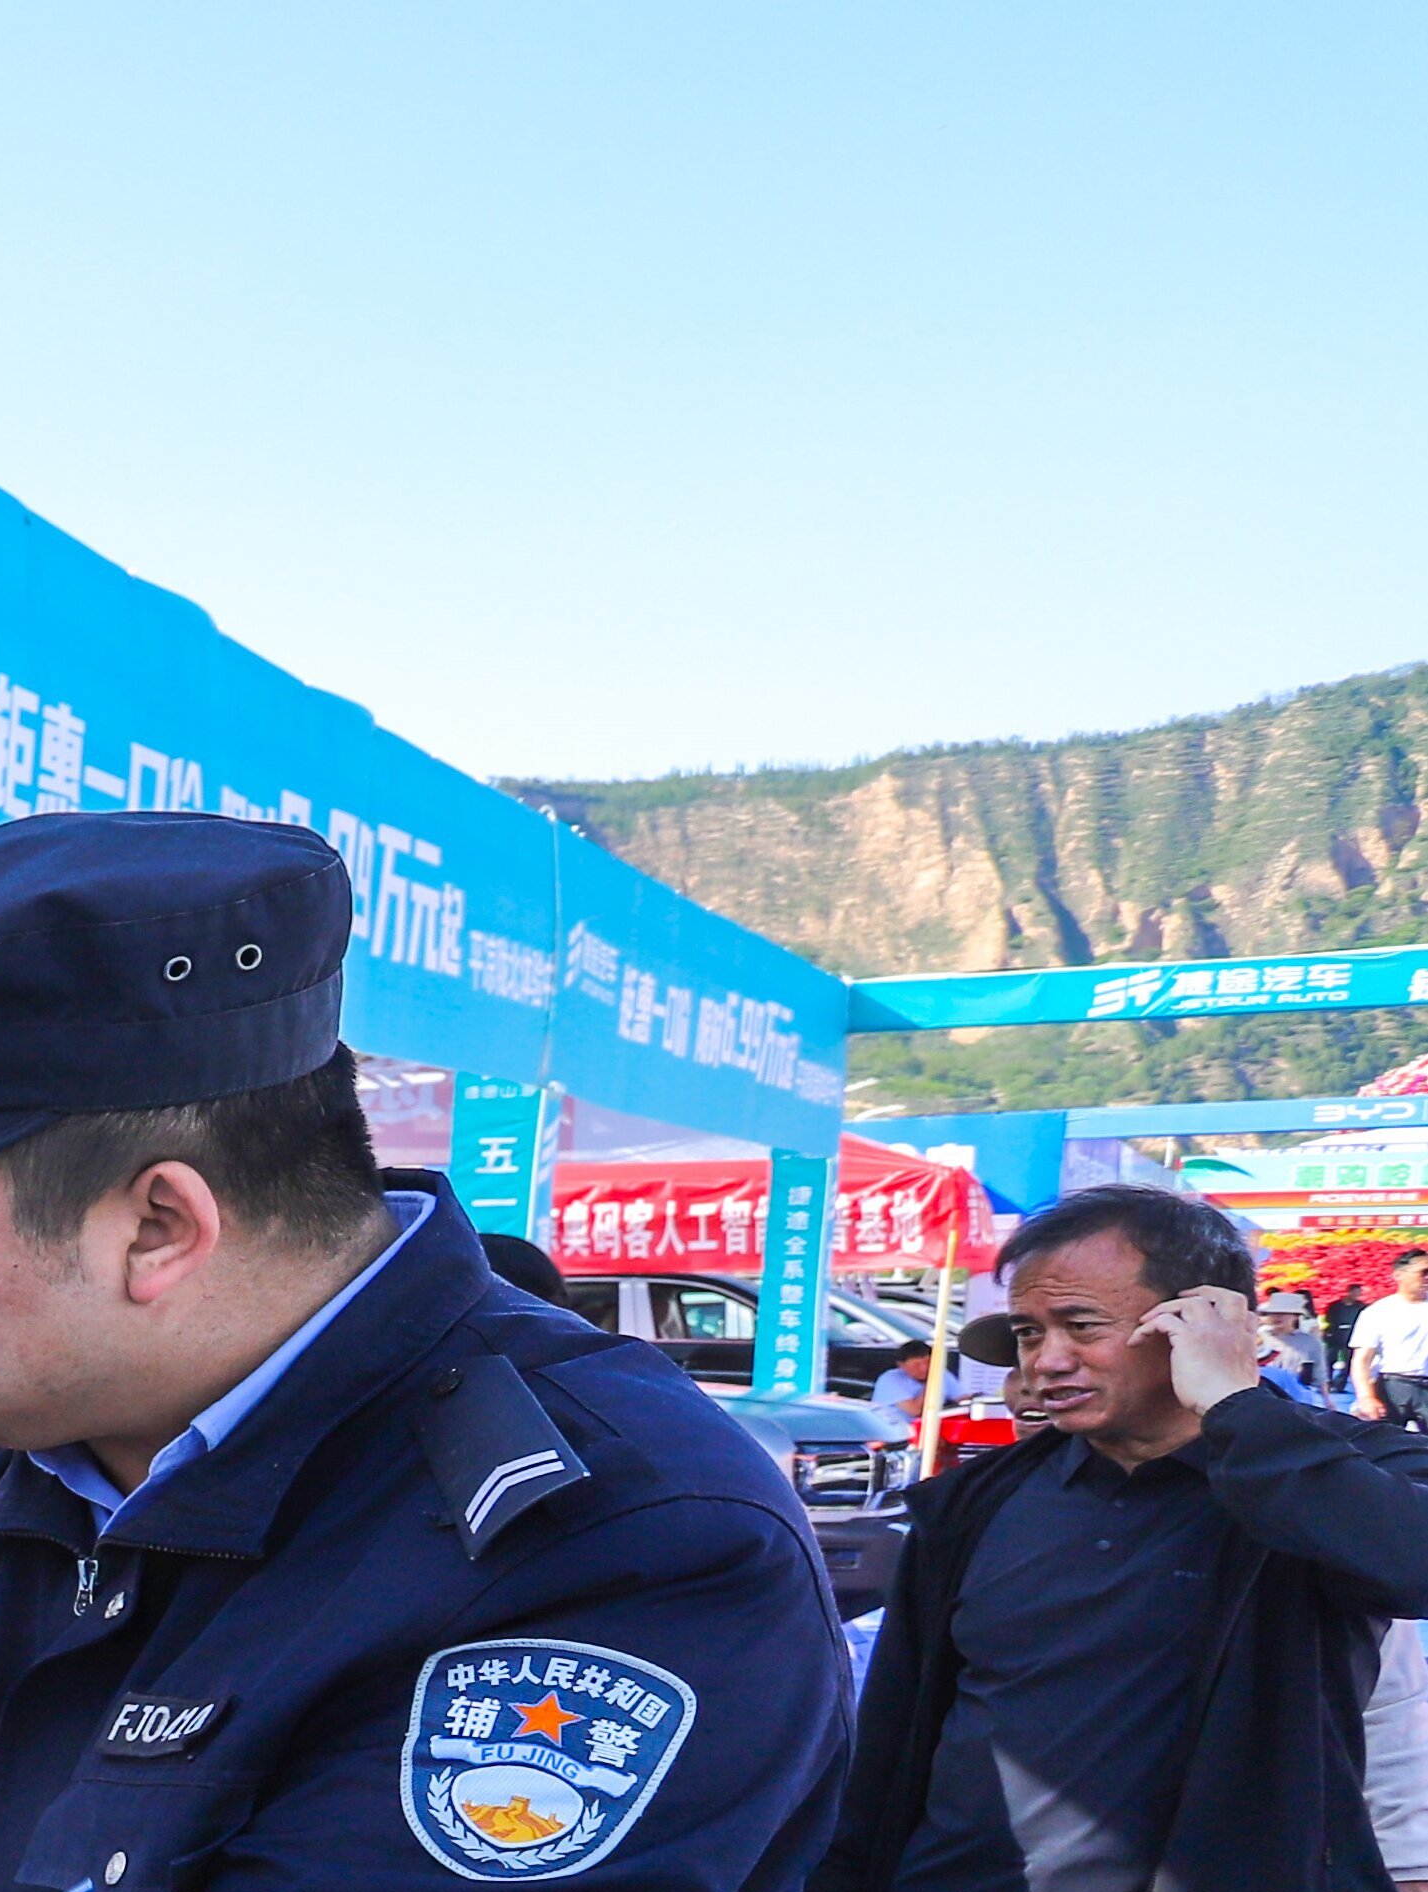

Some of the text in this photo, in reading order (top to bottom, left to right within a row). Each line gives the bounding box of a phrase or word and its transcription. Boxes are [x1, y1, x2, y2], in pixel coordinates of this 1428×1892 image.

[1170, 963, 1352, 998] 捷途汽车
[1171, 990, 1351, 1011] JETOUR AUTO
[1313, 1102, 1416, 1123] BYD
[446, 1655, 672, 1730] 中华人民共和国
[443, 1695, 643, 1768] 辅 警
[480, 1745, 581, 1780] FU JING
